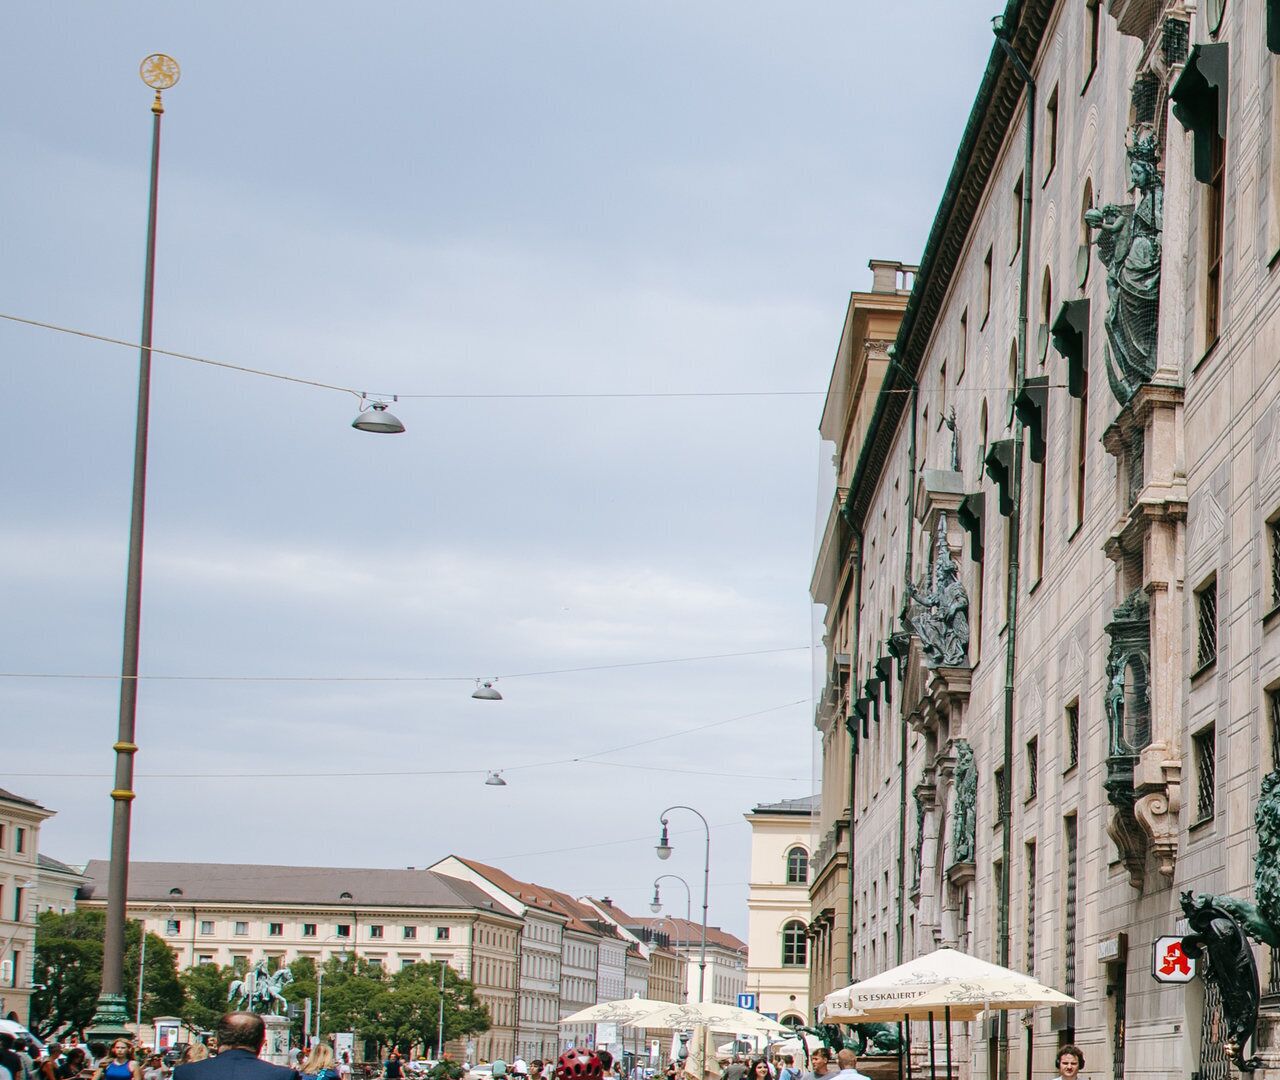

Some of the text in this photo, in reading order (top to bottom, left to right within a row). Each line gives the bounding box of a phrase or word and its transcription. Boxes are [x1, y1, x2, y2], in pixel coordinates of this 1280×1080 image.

[740, 995, 752, 1009] U
[858, 994, 869, 1002] ES
[870, 991, 916, 1001] ESKALIERT
